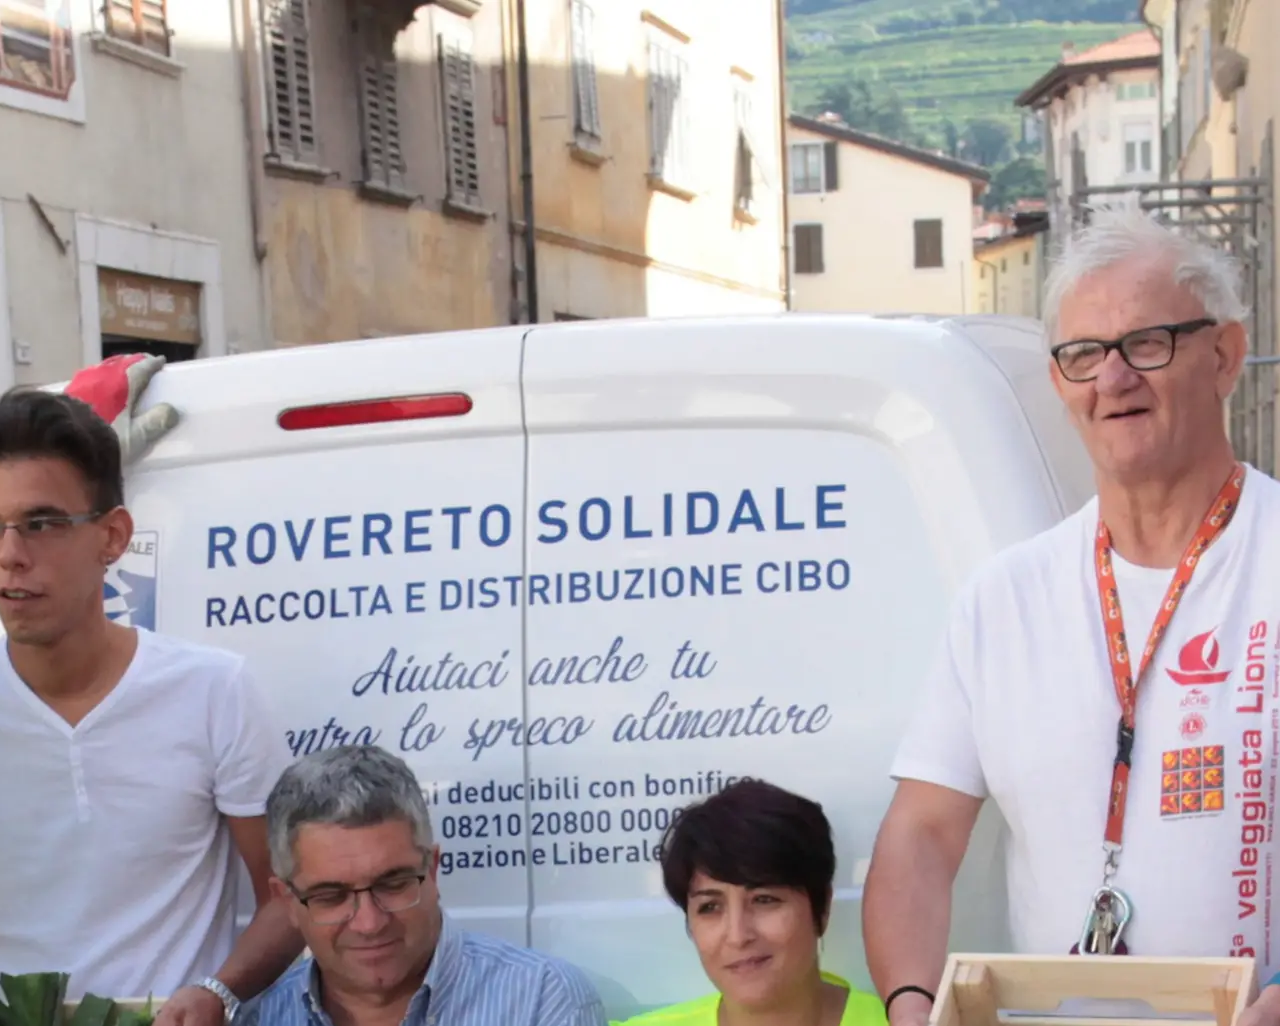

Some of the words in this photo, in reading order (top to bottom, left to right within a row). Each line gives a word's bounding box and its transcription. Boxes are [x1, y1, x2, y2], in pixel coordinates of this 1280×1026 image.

[207, 503, 511, 569] ROVERETO
[537, 484, 847, 544] SOLIDALE
[206, 584, 393, 627] RACCOLTA
[405, 581, 426, 613] E
[440, 563, 743, 611] DISTRIBUZIONE
[756, 558, 850, 594] CIBO
[351, 647, 511, 696] Aiutaci
[527, 635, 649, 686] anche
[669, 639, 719, 680] tu
[1236, 620, 1268, 714] Lions
[399, 702, 447, 751] lo
[463, 714, 595, 762] spreco
[613, 691, 833, 742] alimentare
[442, 814, 521, 839] 08210
[531, 809, 612, 836] 20800
[447, 777, 579, 805] deducibili
[588, 778, 635, 799] con
[1232, 729, 1267, 921] veleggiata
[553, 839, 663, 866] Liberale
